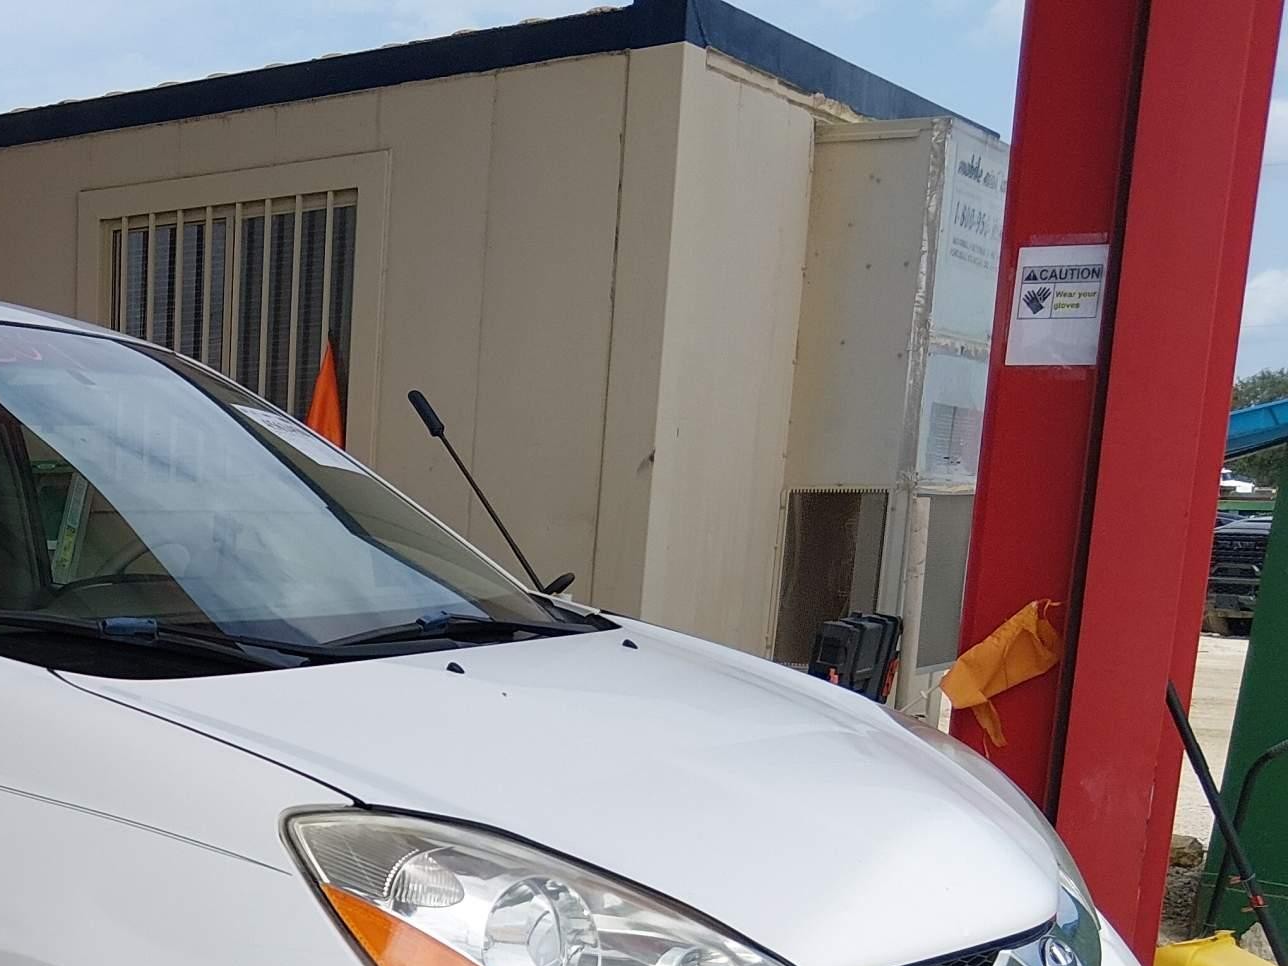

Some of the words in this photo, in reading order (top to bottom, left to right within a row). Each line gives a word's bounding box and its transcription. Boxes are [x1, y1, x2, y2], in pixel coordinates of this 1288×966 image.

[1039, 267, 1101, 281] CAUTION
[1055, 290, 1075, 298] Wear
[1078, 291, 1097, 299] your
[1053, 302, 1080, 311] gloves
